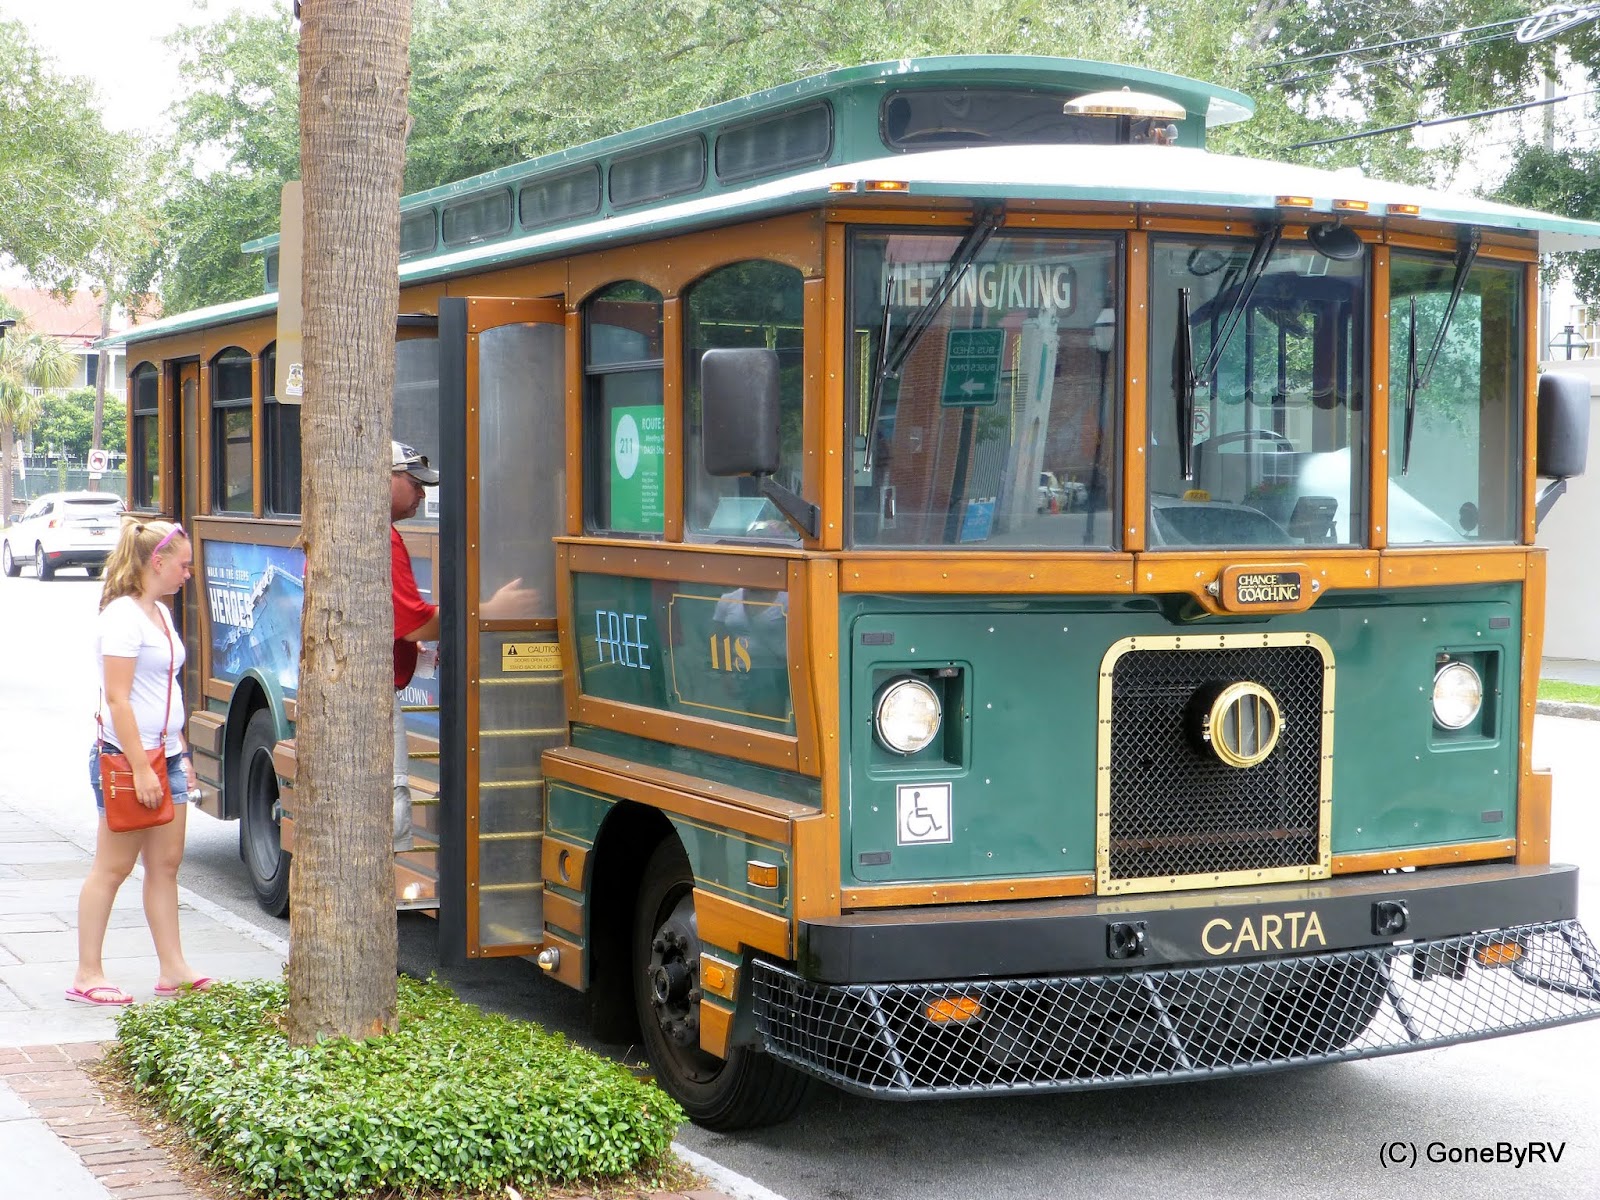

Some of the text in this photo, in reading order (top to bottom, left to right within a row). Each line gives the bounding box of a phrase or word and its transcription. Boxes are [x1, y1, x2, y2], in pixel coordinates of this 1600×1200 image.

[642, 417, 661, 430] ROUTE
[620, 437, 632, 454] 211
[1238, 574, 1277, 585] CHANCE
[209, 587, 254, 630] HEROES
[527, 645, 561, 653] CAUTION
[595, 609, 650, 670] FREE
[710, 633, 752, 673] 118
[1201, 911, 1326, 956] CARTA
